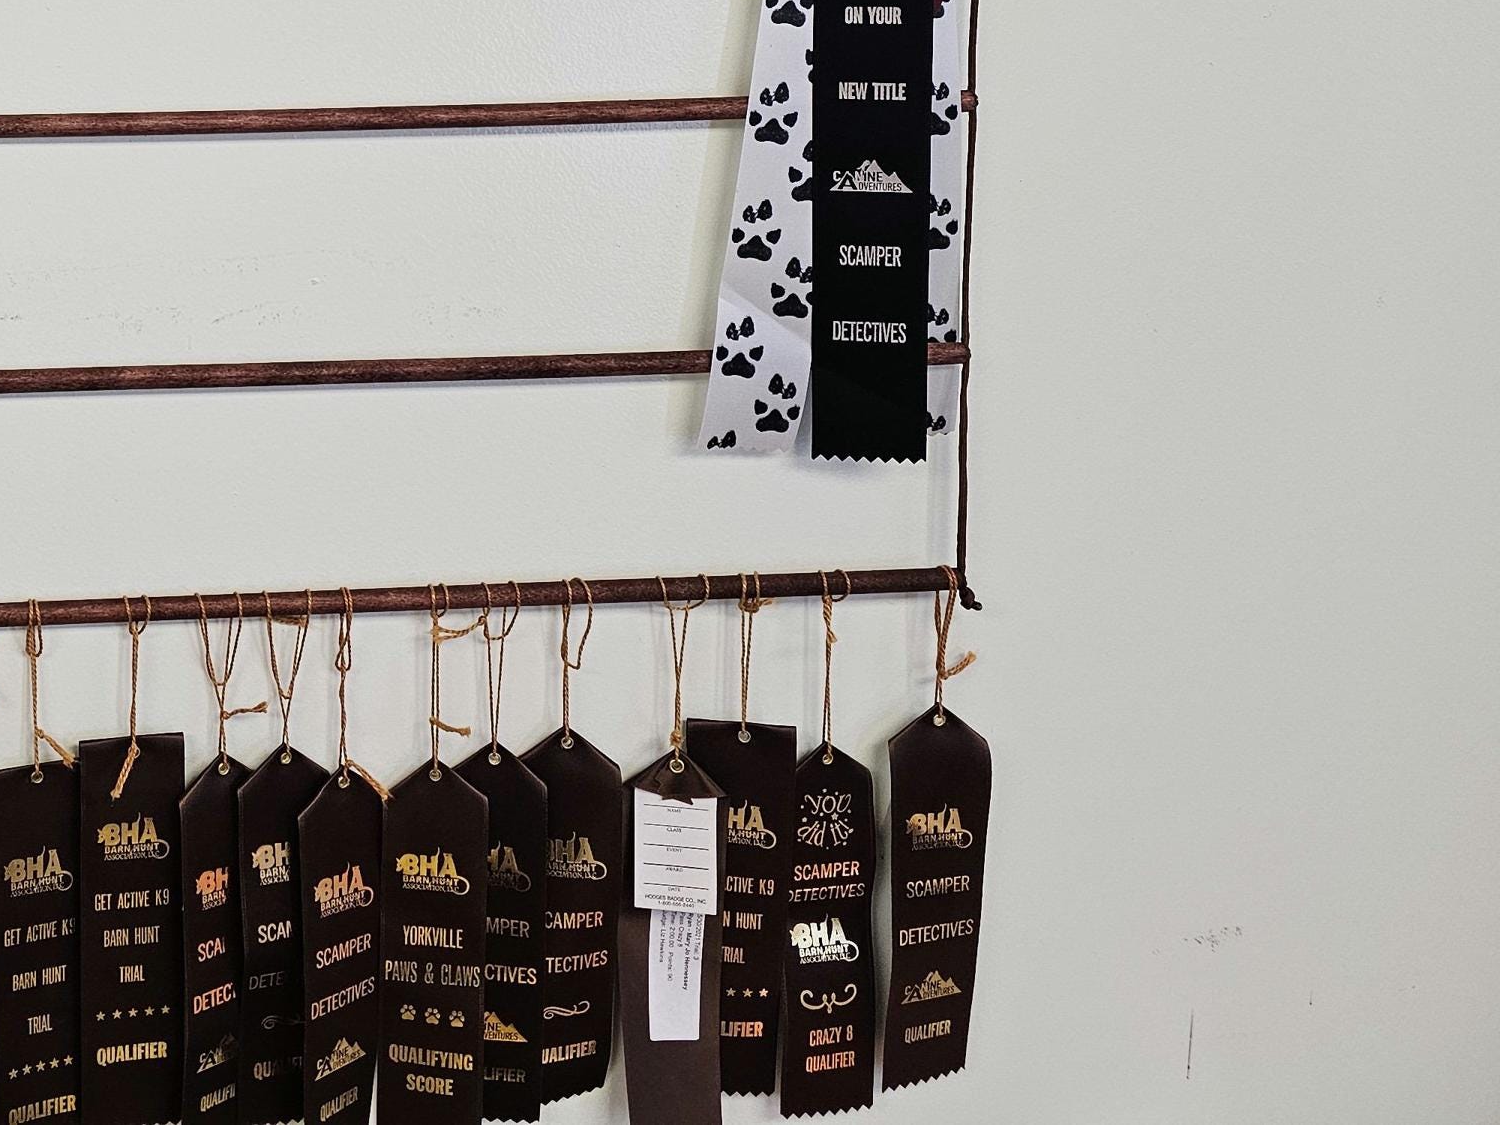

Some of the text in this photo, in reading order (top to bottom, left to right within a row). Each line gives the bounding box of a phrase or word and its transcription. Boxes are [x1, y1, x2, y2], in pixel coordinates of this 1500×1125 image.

[844, 6, 902, 25] ON YOUR
[838, 82, 907, 101] NEW TITLE
[839, 245, 902, 267] SCAMPER
[832, 321, 907, 344] DETECTIVES
[728, 806, 764, 831] HA
[908, 808, 963, 837] BHA
[101, 817, 158, 846] BHA
[797, 820, 827, 847] did
[7, 848, 62, 882] BHA
[398, 852, 458, 876] BHA
[793, 861, 860, 881] SCAMPER
[10, 880, 36, 892] BARN
[317, 865, 365, 904] BHA
[402, 875, 430, 884] BARN
[758, 876, 775, 896] K9
[906, 875, 971, 899] SCAMPER
[94, 888, 170, 912] GET ACTIVE K9
[3, 920, 58, 948] GET ACTIVE
[735, 913, 763, 931] HUNT
[791, 917, 847, 949] BHA
[899, 918, 974, 947] DETECTIVES
[103, 925, 160, 948] BARN HUNT
[402, 924, 463, 950] YORKVILLE
[316, 933, 372, 970] SCAMPER
[799, 946, 823, 957] BARN
[12, 964, 67, 992] BARN HUNT
[119, 965, 145, 983] TRIAL
[385, 960, 481, 988] PAWS & CLAWS
[311, 976, 375, 1021] DETECTIVES
[27, 1015, 53, 1035] TRIAL
[809, 1025, 853, 1047] CRAZY 8
[904, 1020, 951, 1045] QUALIFIER
[96, 1041, 167, 1067] QUALIFIER
[388, 1043, 473, 1072] QUALIFYING
[806, 1051, 855, 1073] QUALIFIER
[406, 1073, 454, 1097] SCORE
[8, 1094, 76, 1125] QUALIFIER
[320, 1086, 359, 1123] QUALIFIER
